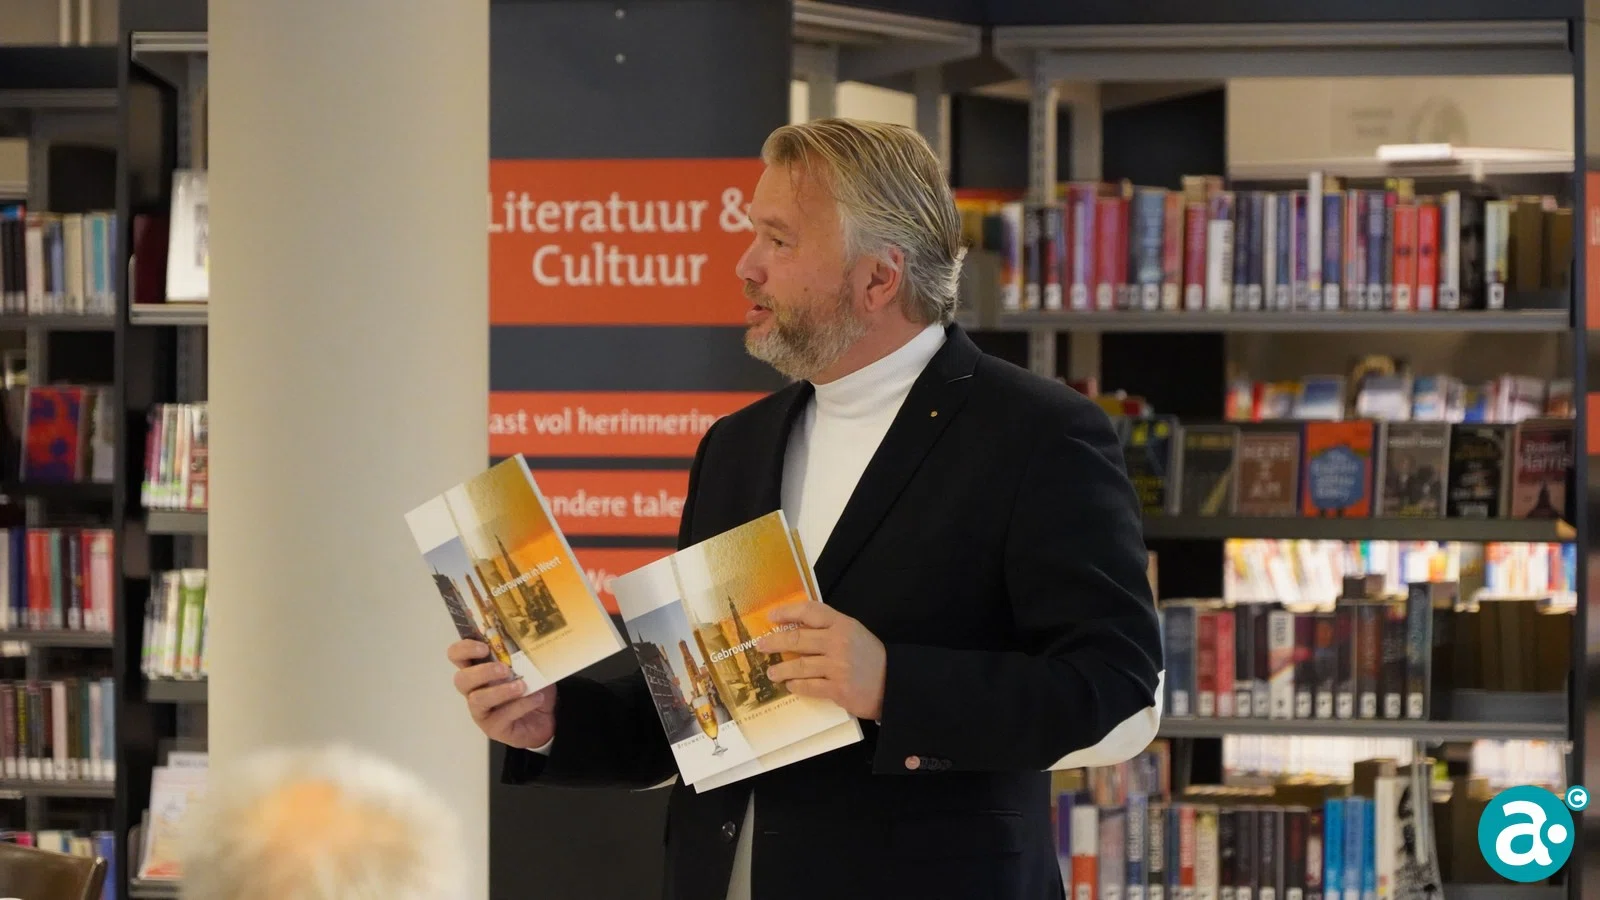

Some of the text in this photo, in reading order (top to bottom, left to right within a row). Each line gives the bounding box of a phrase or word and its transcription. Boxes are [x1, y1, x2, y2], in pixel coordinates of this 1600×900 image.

[488, 187, 755, 233] Literatuur &
[532, 242, 709, 287] Cultuur
[488, 405, 720, 435] ast vol herinnerin
[632, 489, 686, 518] tale
[491, 571, 530, 597] Gebrouwen
[536, 555, 562, 573] Weert
